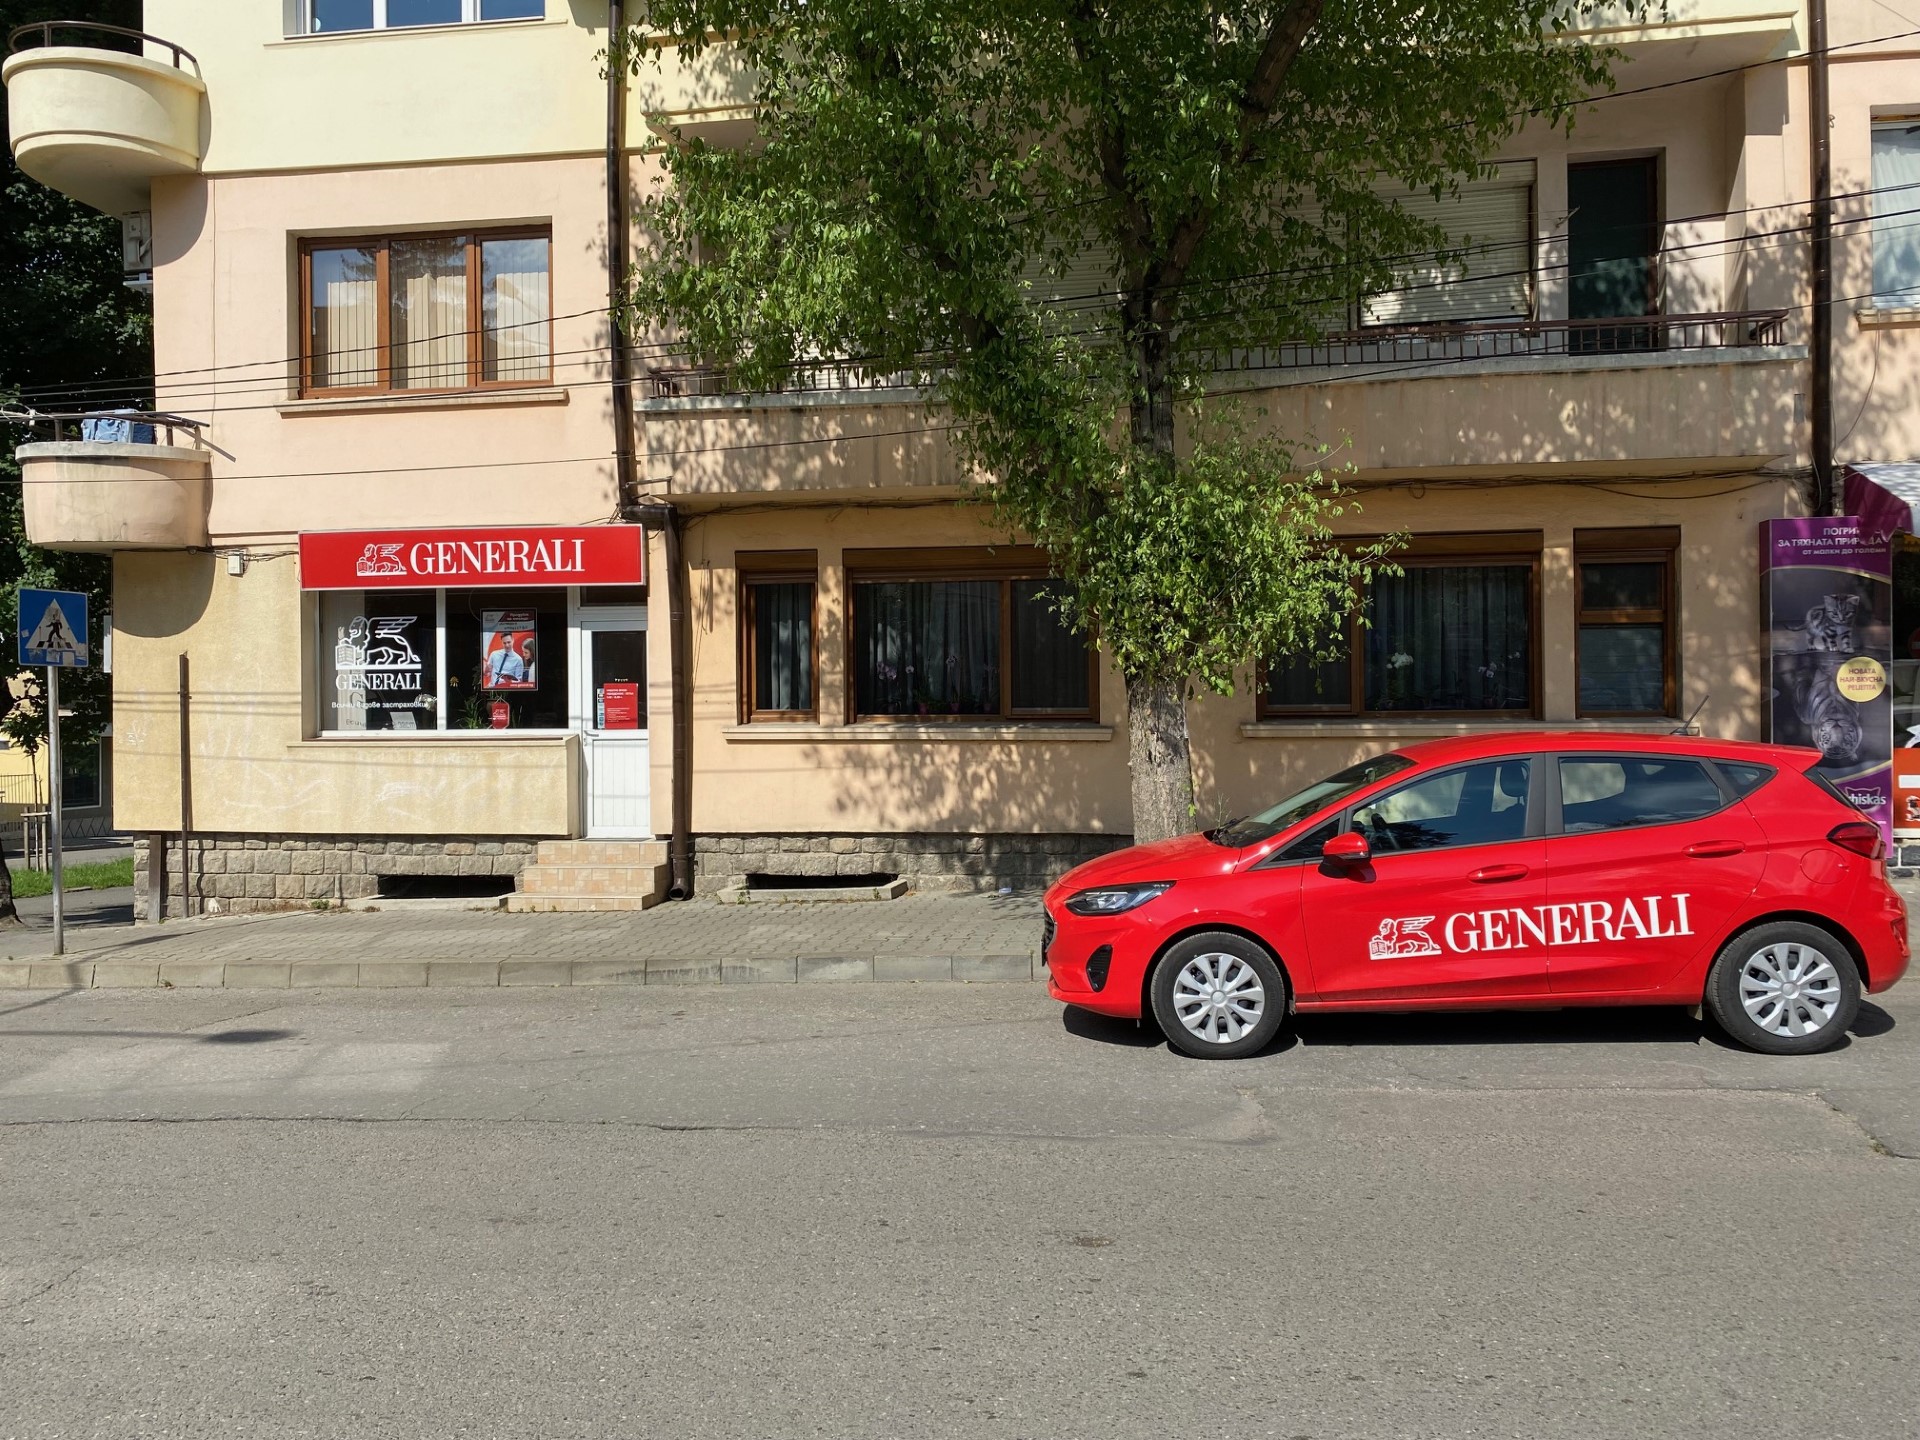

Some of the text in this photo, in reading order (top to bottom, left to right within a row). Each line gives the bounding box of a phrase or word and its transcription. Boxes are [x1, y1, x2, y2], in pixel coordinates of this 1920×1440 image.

[1823, 527, 1859, 536] ПОГРИ
[1778, 537, 1883, 547] ЗА ТЯХНАТА ПРИРДА
[410, 539, 585, 575] GENERALI
[335, 672, 422, 690] GENERALI
[1849, 793, 1887, 805] hiskas
[1444, 893, 1695, 953] GENERALI
